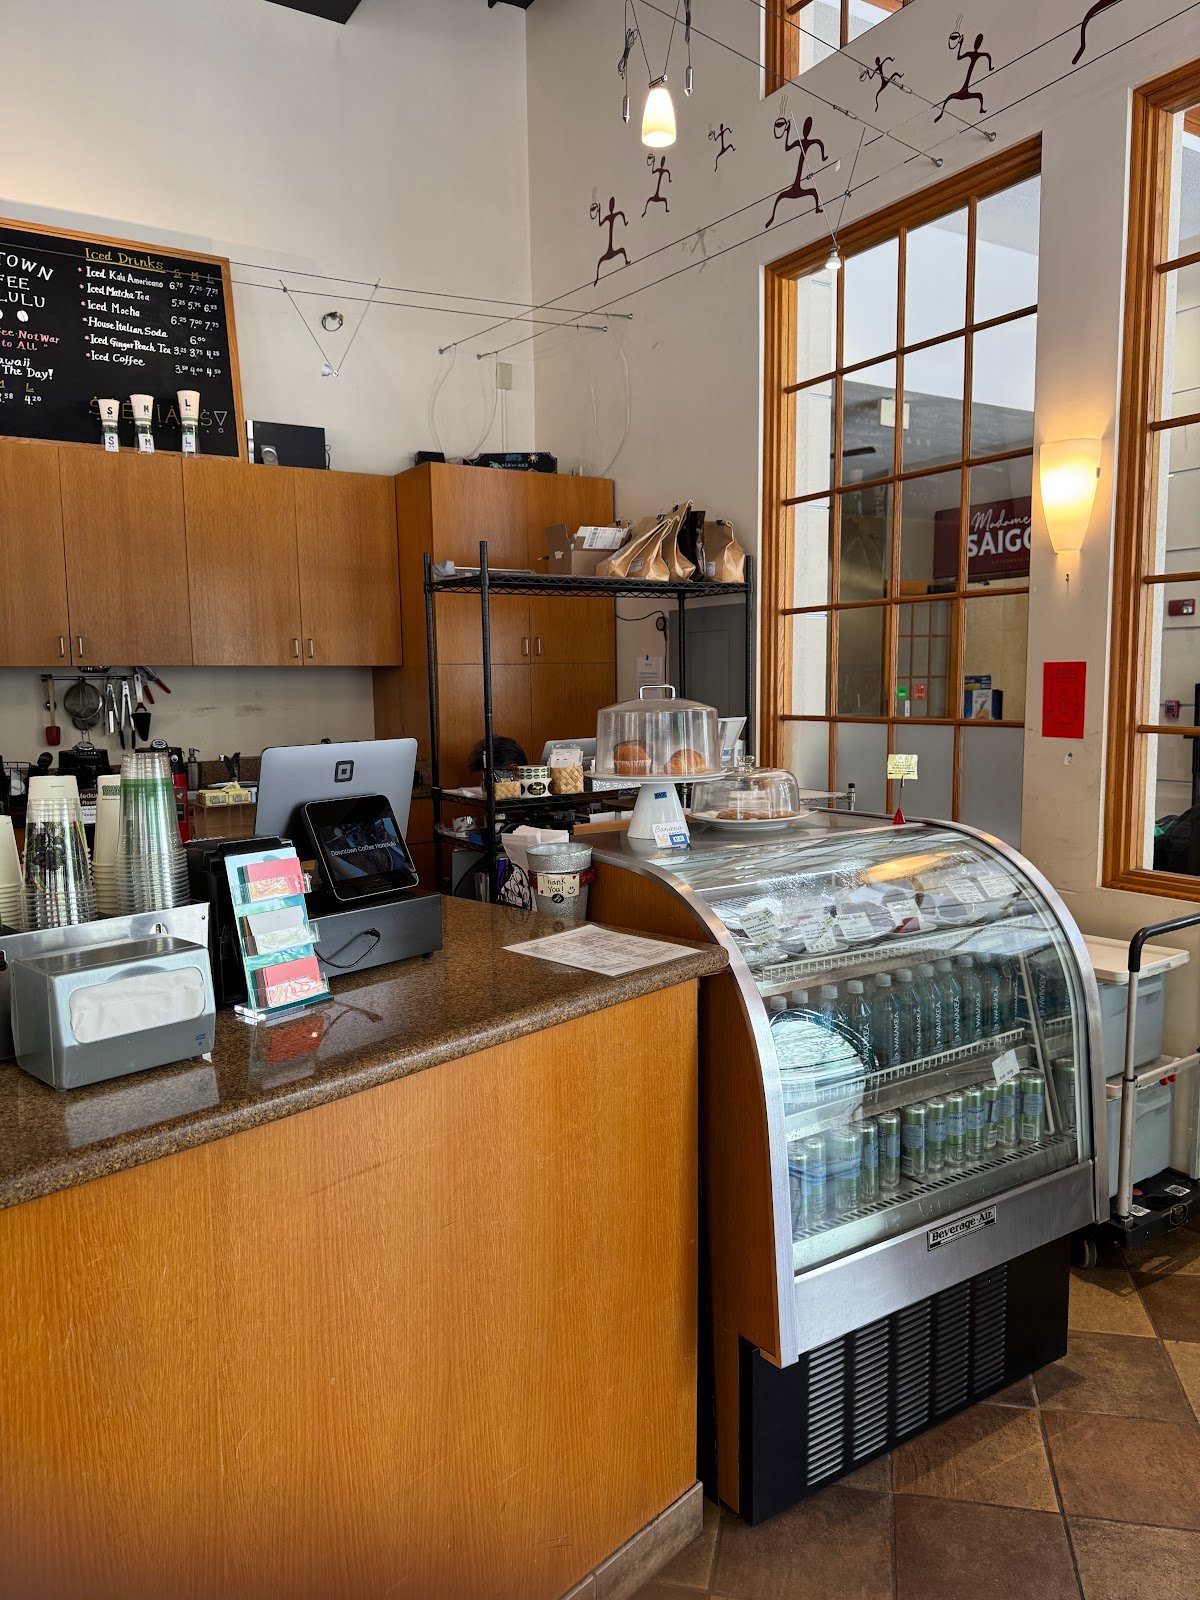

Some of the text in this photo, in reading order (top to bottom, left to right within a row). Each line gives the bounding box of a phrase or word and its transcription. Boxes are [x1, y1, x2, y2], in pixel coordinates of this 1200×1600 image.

[85, 248, 164, 270] Iced Drinks
[0, 274, 30, 290] EE
[86, 266, 107, 279] Iced
[127, 273, 164, 288] Americano
[86, 283, 106, 295] Iced
[106, 286, 135, 299] Matcha
[135, 290, 150, 301] Tea
[87, 300, 108, 312] Iced
[111, 302, 140, 317] Mocha
[88, 316, 115, 330] House
[115, 320, 143, 335] Italian
[144, 327, 168, 338] Soda
[90, 334, 109, 346] Iced
[109, 337, 134, 351] Ginger
[133, 340, 156, 352] Peach
[157, 343, 171, 354] Tea
[91, 350, 110, 362] Iced
[112, 353, 146, 367] Coffee
[1, 364, 54, 382] The Day!
[26, 382, 35, 392] L
[24, 394, 42, 405] 4.20
[107, 406, 113, 415] S
[108, 436, 114, 445] S
[971, 508, 1031, 532] Madame
[331, 847, 358, 857] Downtown
[357, 844, 375, 852] Coffee
